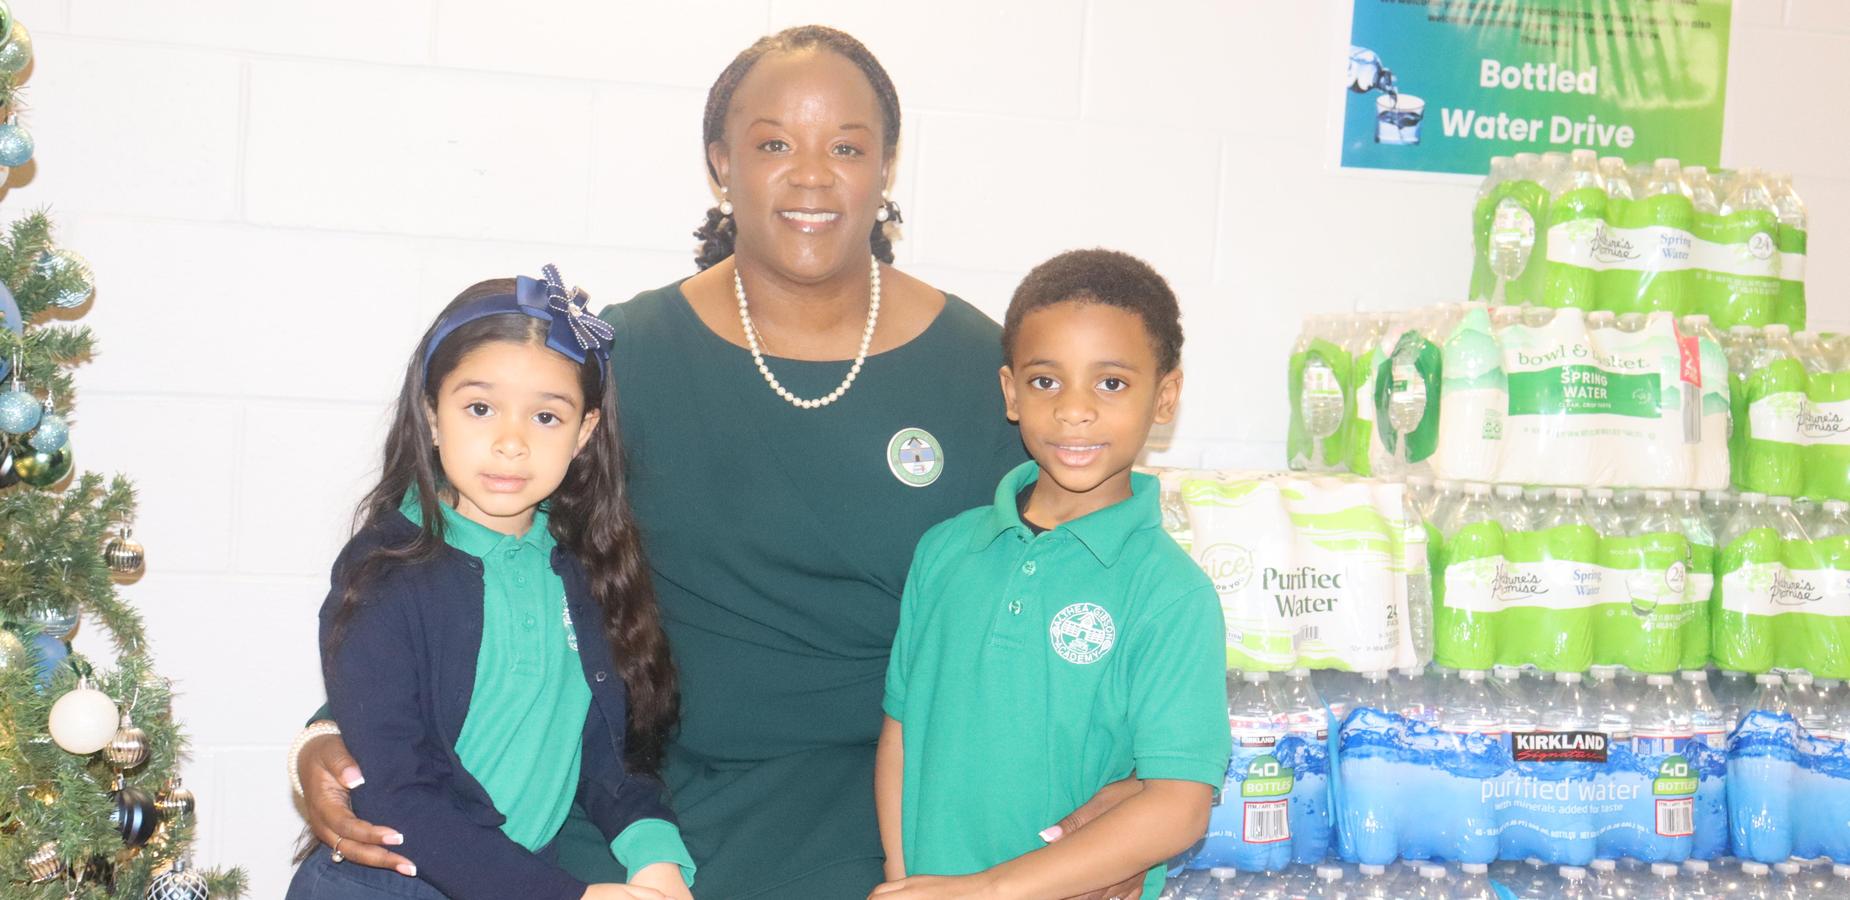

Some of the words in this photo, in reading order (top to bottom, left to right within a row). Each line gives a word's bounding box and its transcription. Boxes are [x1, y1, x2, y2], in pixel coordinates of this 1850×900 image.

[1480, 59, 1598, 95] Bottled
[1441, 108, 1544, 143] Water
[1549, 115, 1635, 149] Drive
[1660, 233, 1692, 250] Spring
[1662, 247, 1689, 260] Water
[1518, 345, 1565, 366] bowl
[1572, 343, 1588, 358] &
[1561, 371, 1608, 387] SPRING
[1563, 386, 1608, 400] WATER
[1573, 567, 1602, 583] Spring
[1574, 584, 1600, 596] Water
[1274, 595, 1339, 618] Water
[1386, 604, 1399, 619] 24
[1241, 736, 1275, 744] KIRKLAND
[1517, 734, 1605, 751] KIRKLAND
[1249, 762, 1279, 777] 40
[1661, 763, 1688, 776] 40
[1246, 780, 1291, 793] BOTTLES
[1481, 777, 1569, 803] purified
[1578, 781, 1640, 801] water
[1657, 781, 1697, 792] BOTTLES
[1513, 800, 1556, 814] minerals
[1559, 803, 1588, 815] added
[1601, 803, 1624, 813] taste
